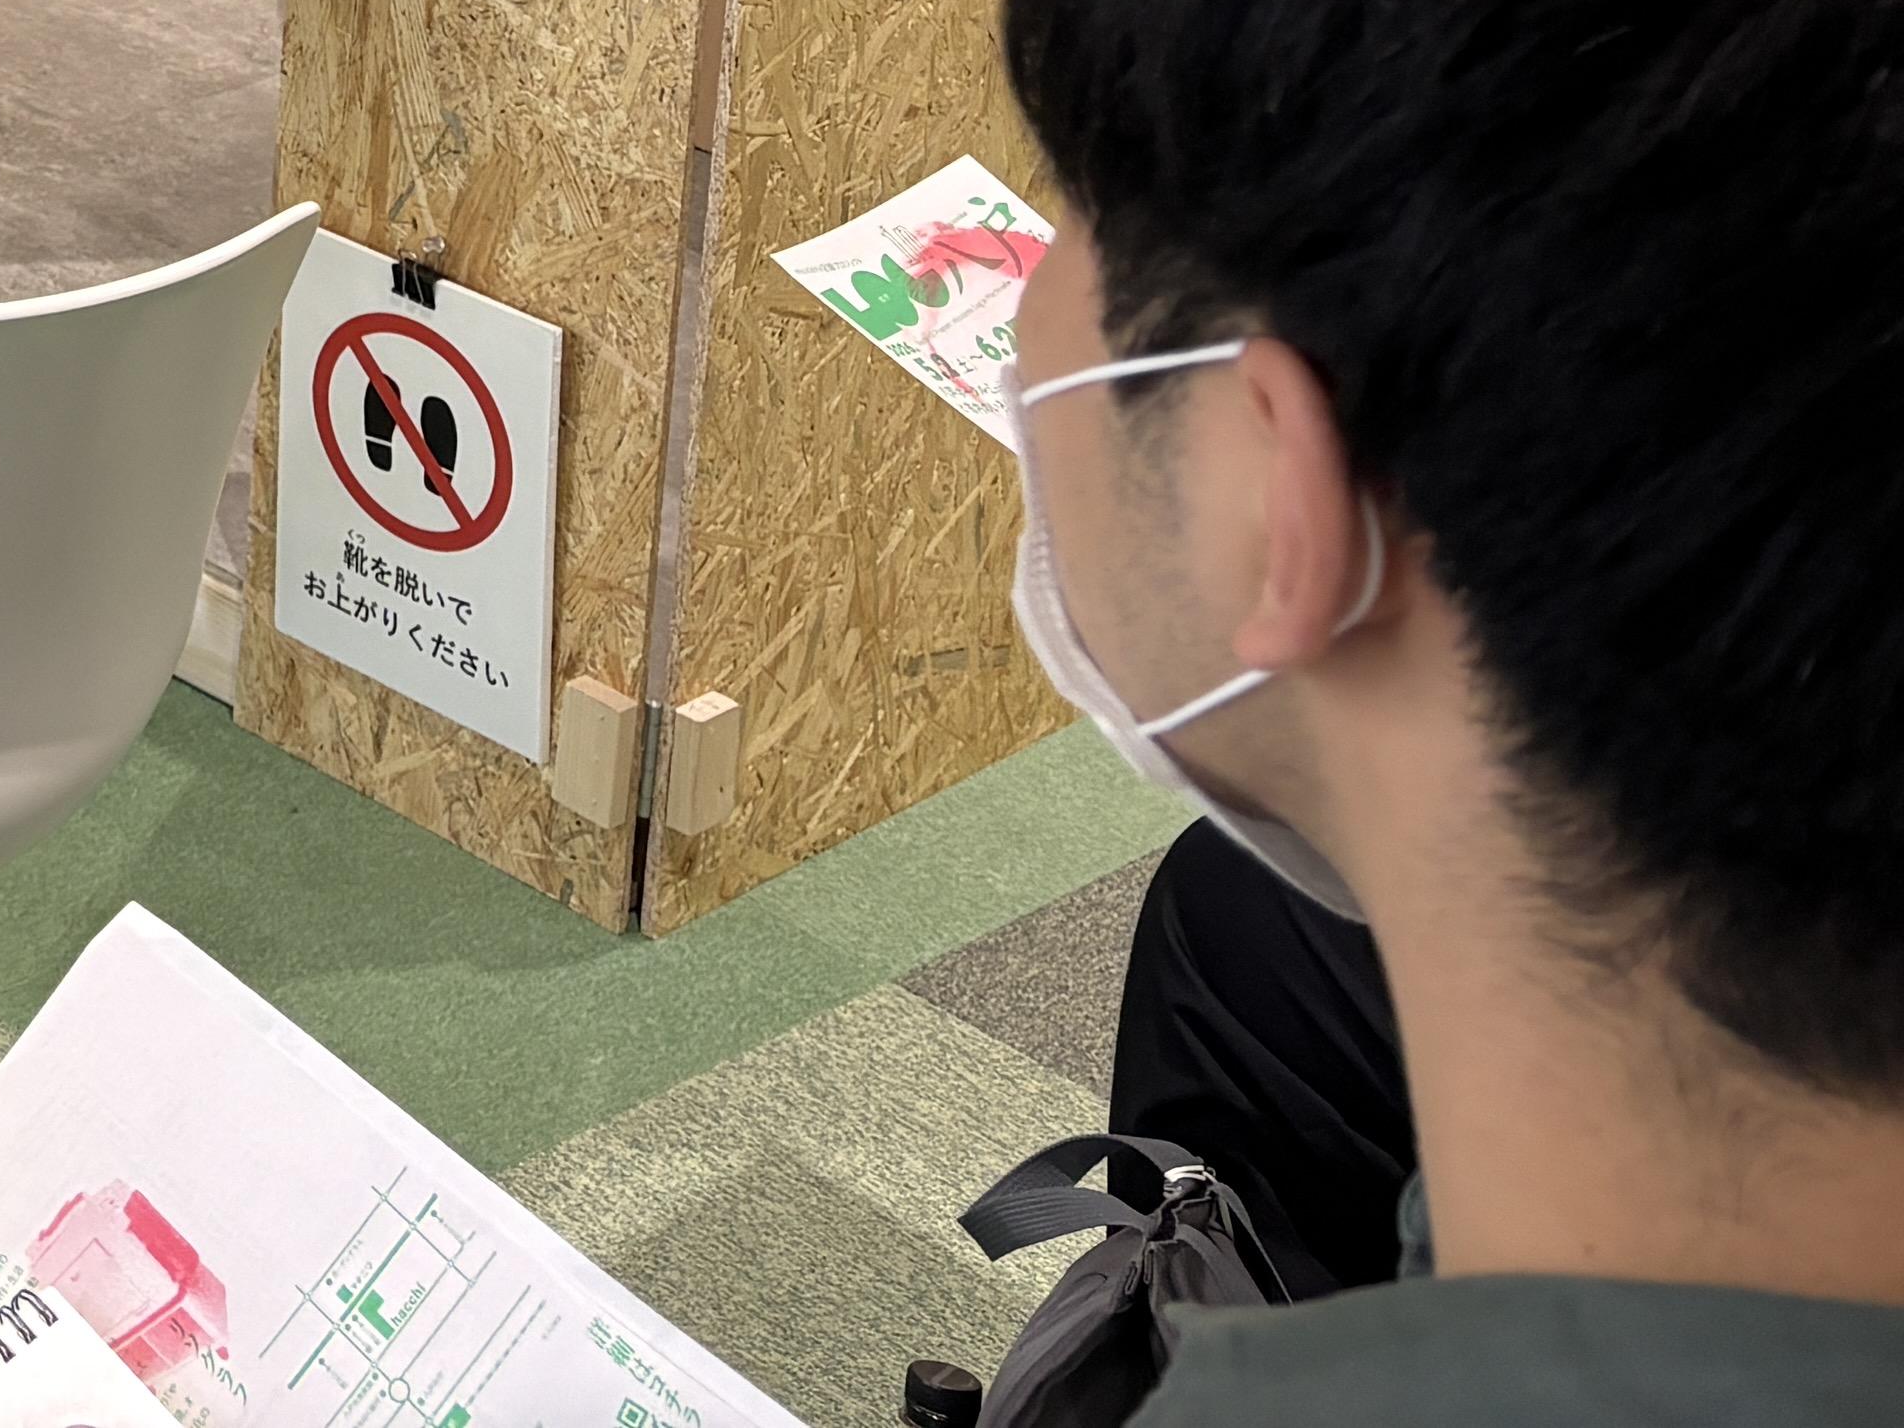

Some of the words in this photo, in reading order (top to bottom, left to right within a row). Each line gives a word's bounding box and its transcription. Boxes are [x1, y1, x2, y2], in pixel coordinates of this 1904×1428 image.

[343, 539, 474, 627] 靴を脱いで
[303, 568, 510, 690] お上がりください
[389, 1281, 428, 1328] hacchi
